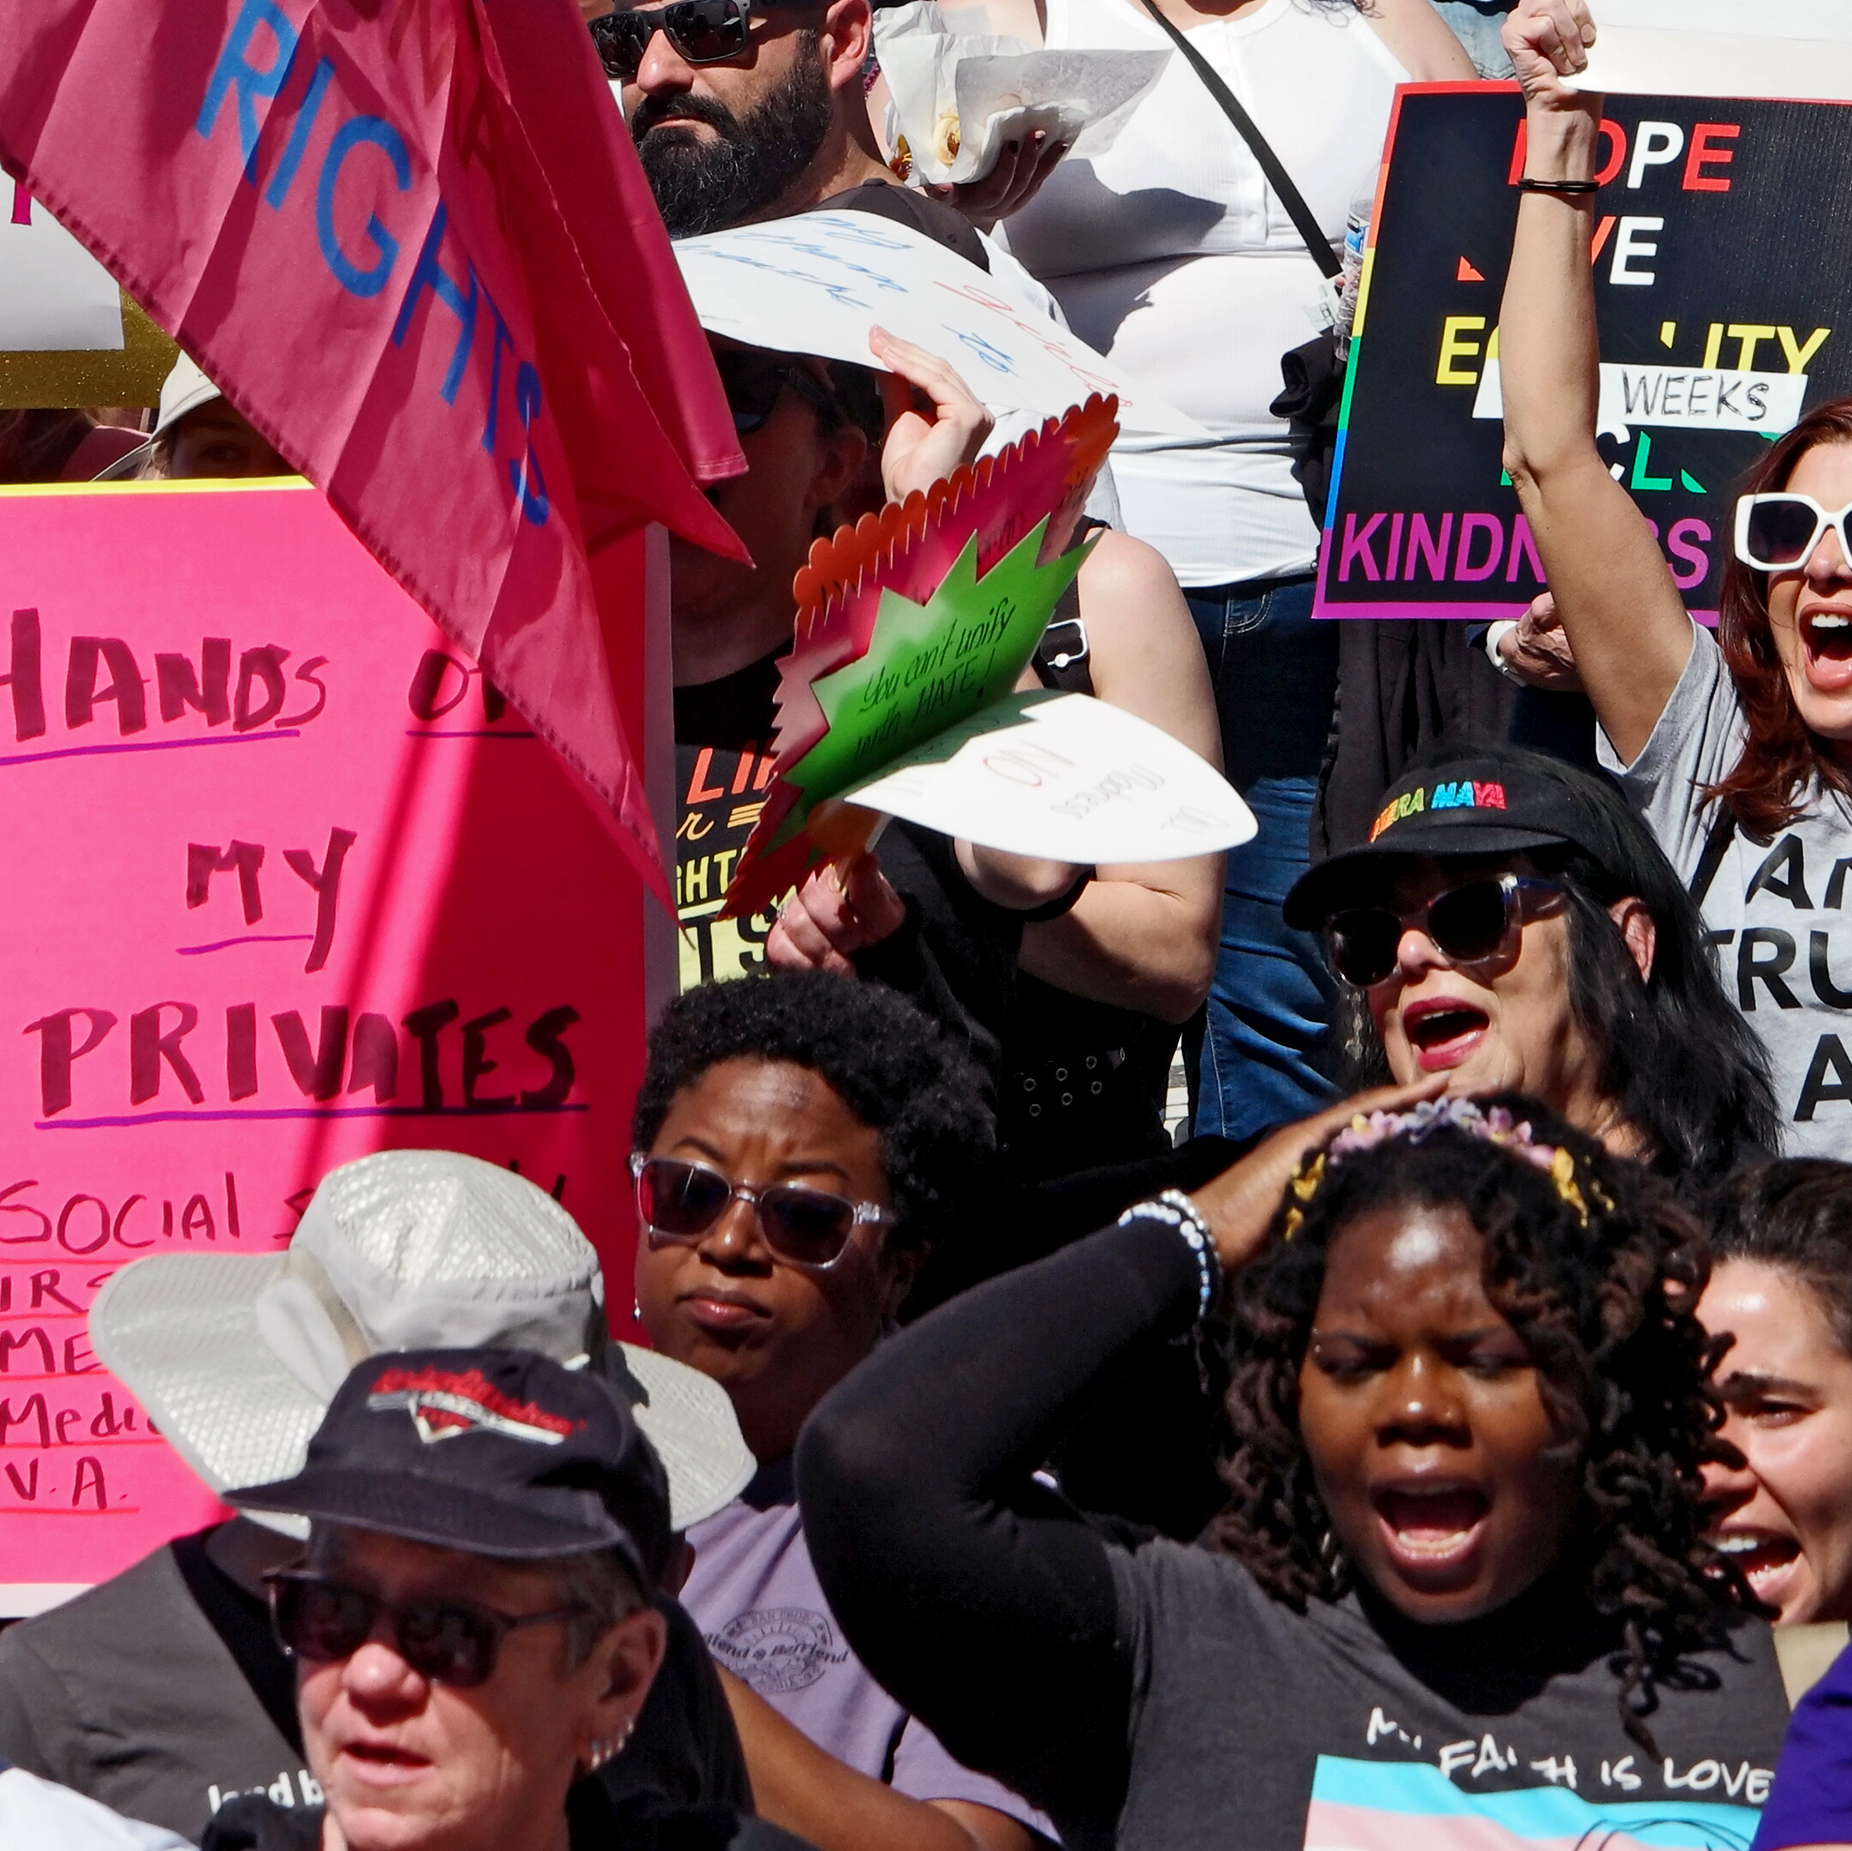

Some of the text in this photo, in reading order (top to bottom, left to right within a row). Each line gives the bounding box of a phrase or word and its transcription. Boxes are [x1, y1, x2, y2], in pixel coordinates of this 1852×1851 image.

[1621, 370, 1769, 421] WEEKS
[858, 597, 1016, 714] You can't unify
[1431, 780, 1507, 810] MAYA
[185, 826, 354, 973] MY
[24, 1001, 582, 1116] PRIVATES
[6, 1456, 128, 1510] V.A.
[1601, 1757, 1775, 1801] IS LOVE
